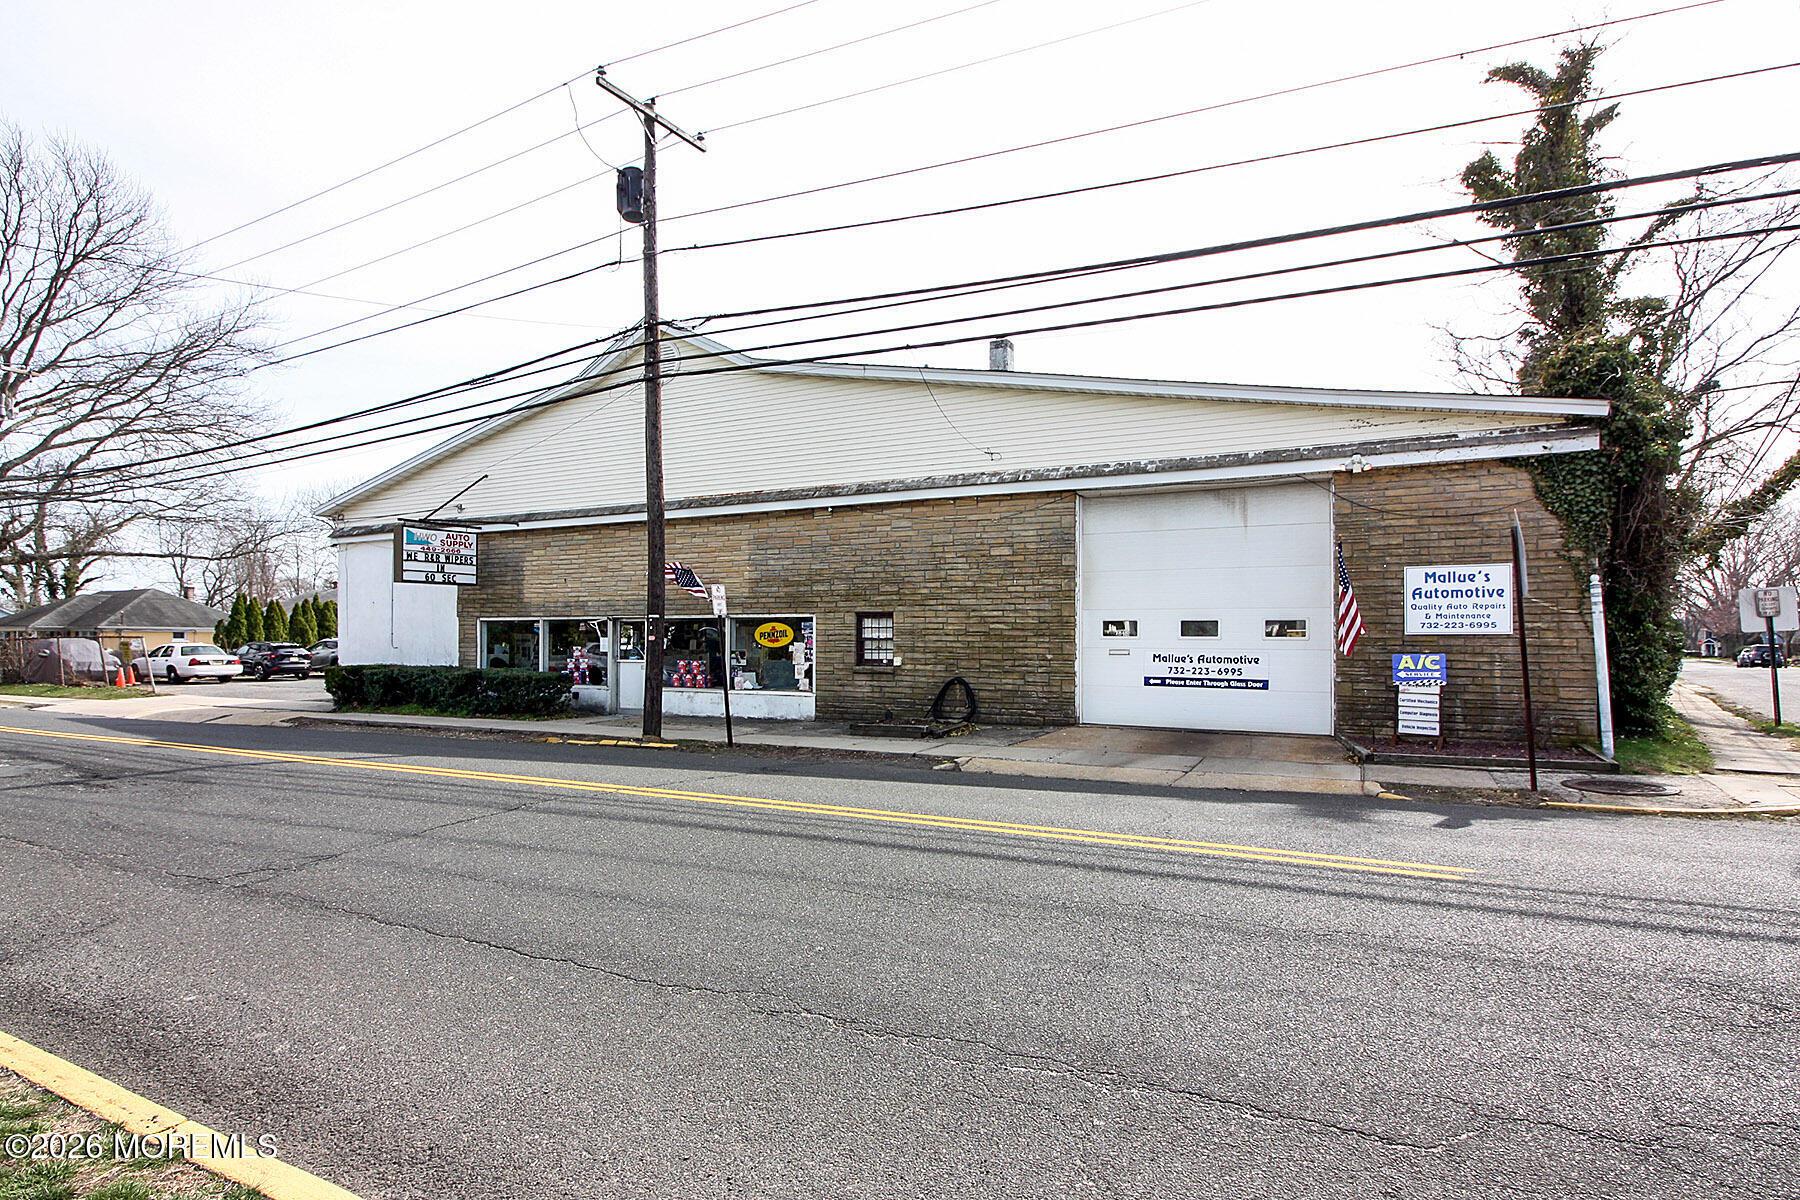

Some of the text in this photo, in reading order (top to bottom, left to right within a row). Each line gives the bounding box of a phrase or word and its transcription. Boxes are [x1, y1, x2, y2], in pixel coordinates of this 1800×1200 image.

[446, 533, 470, 541] AUTO
[440, 540, 473, 548] SUPPLY
[406, 551, 418, 560] WE
[445, 555, 473, 565] WIPERS
[436, 564, 445, 572] IN
[425, 573, 456, 582] 60 SEC
[1424, 570, 1491, 583] Mallue's
[1412, 586, 1505, 600] Automotive
[1410, 603, 1443, 611] Quality
[1472, 603, 1506, 611] Repairs
[760, 630, 788, 640] PENNZOIL
[1152, 653, 1260, 664] Mallue's Automotive
[1398, 655, 1440, 669] A/C
[1168, 666, 1243, 676] 732-223-6995
